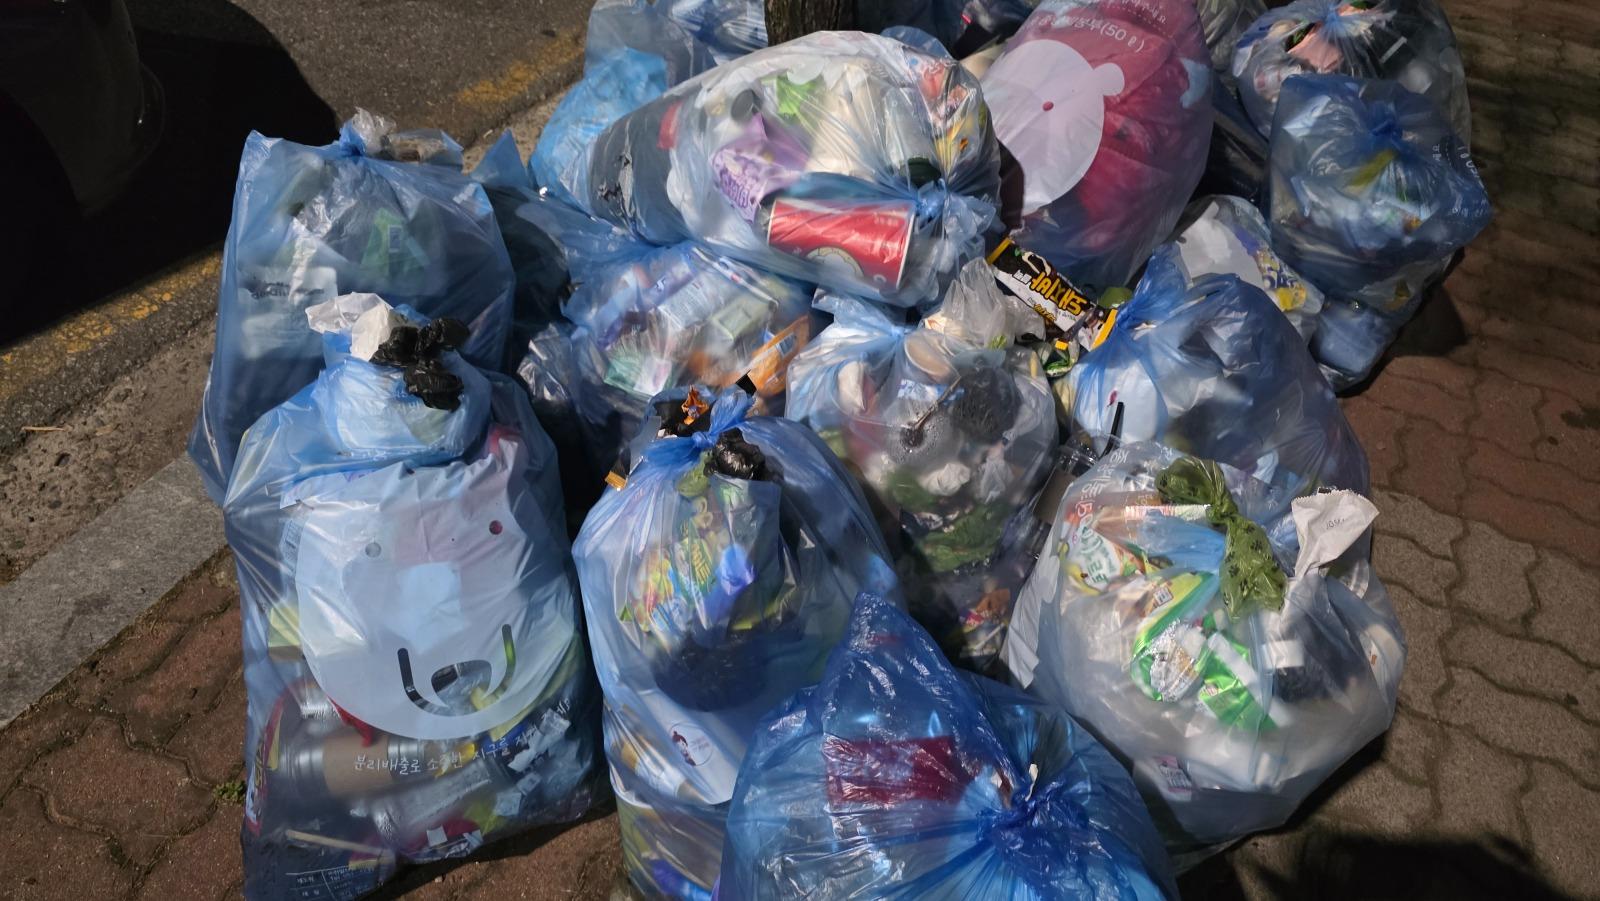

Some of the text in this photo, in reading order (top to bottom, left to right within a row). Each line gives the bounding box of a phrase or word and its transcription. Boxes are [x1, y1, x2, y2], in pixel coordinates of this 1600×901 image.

[1030, 271, 1088, 316] 돼지바
[354, 754, 421, 775] 분리배출로
[472, 736, 511, 760] 지구를
